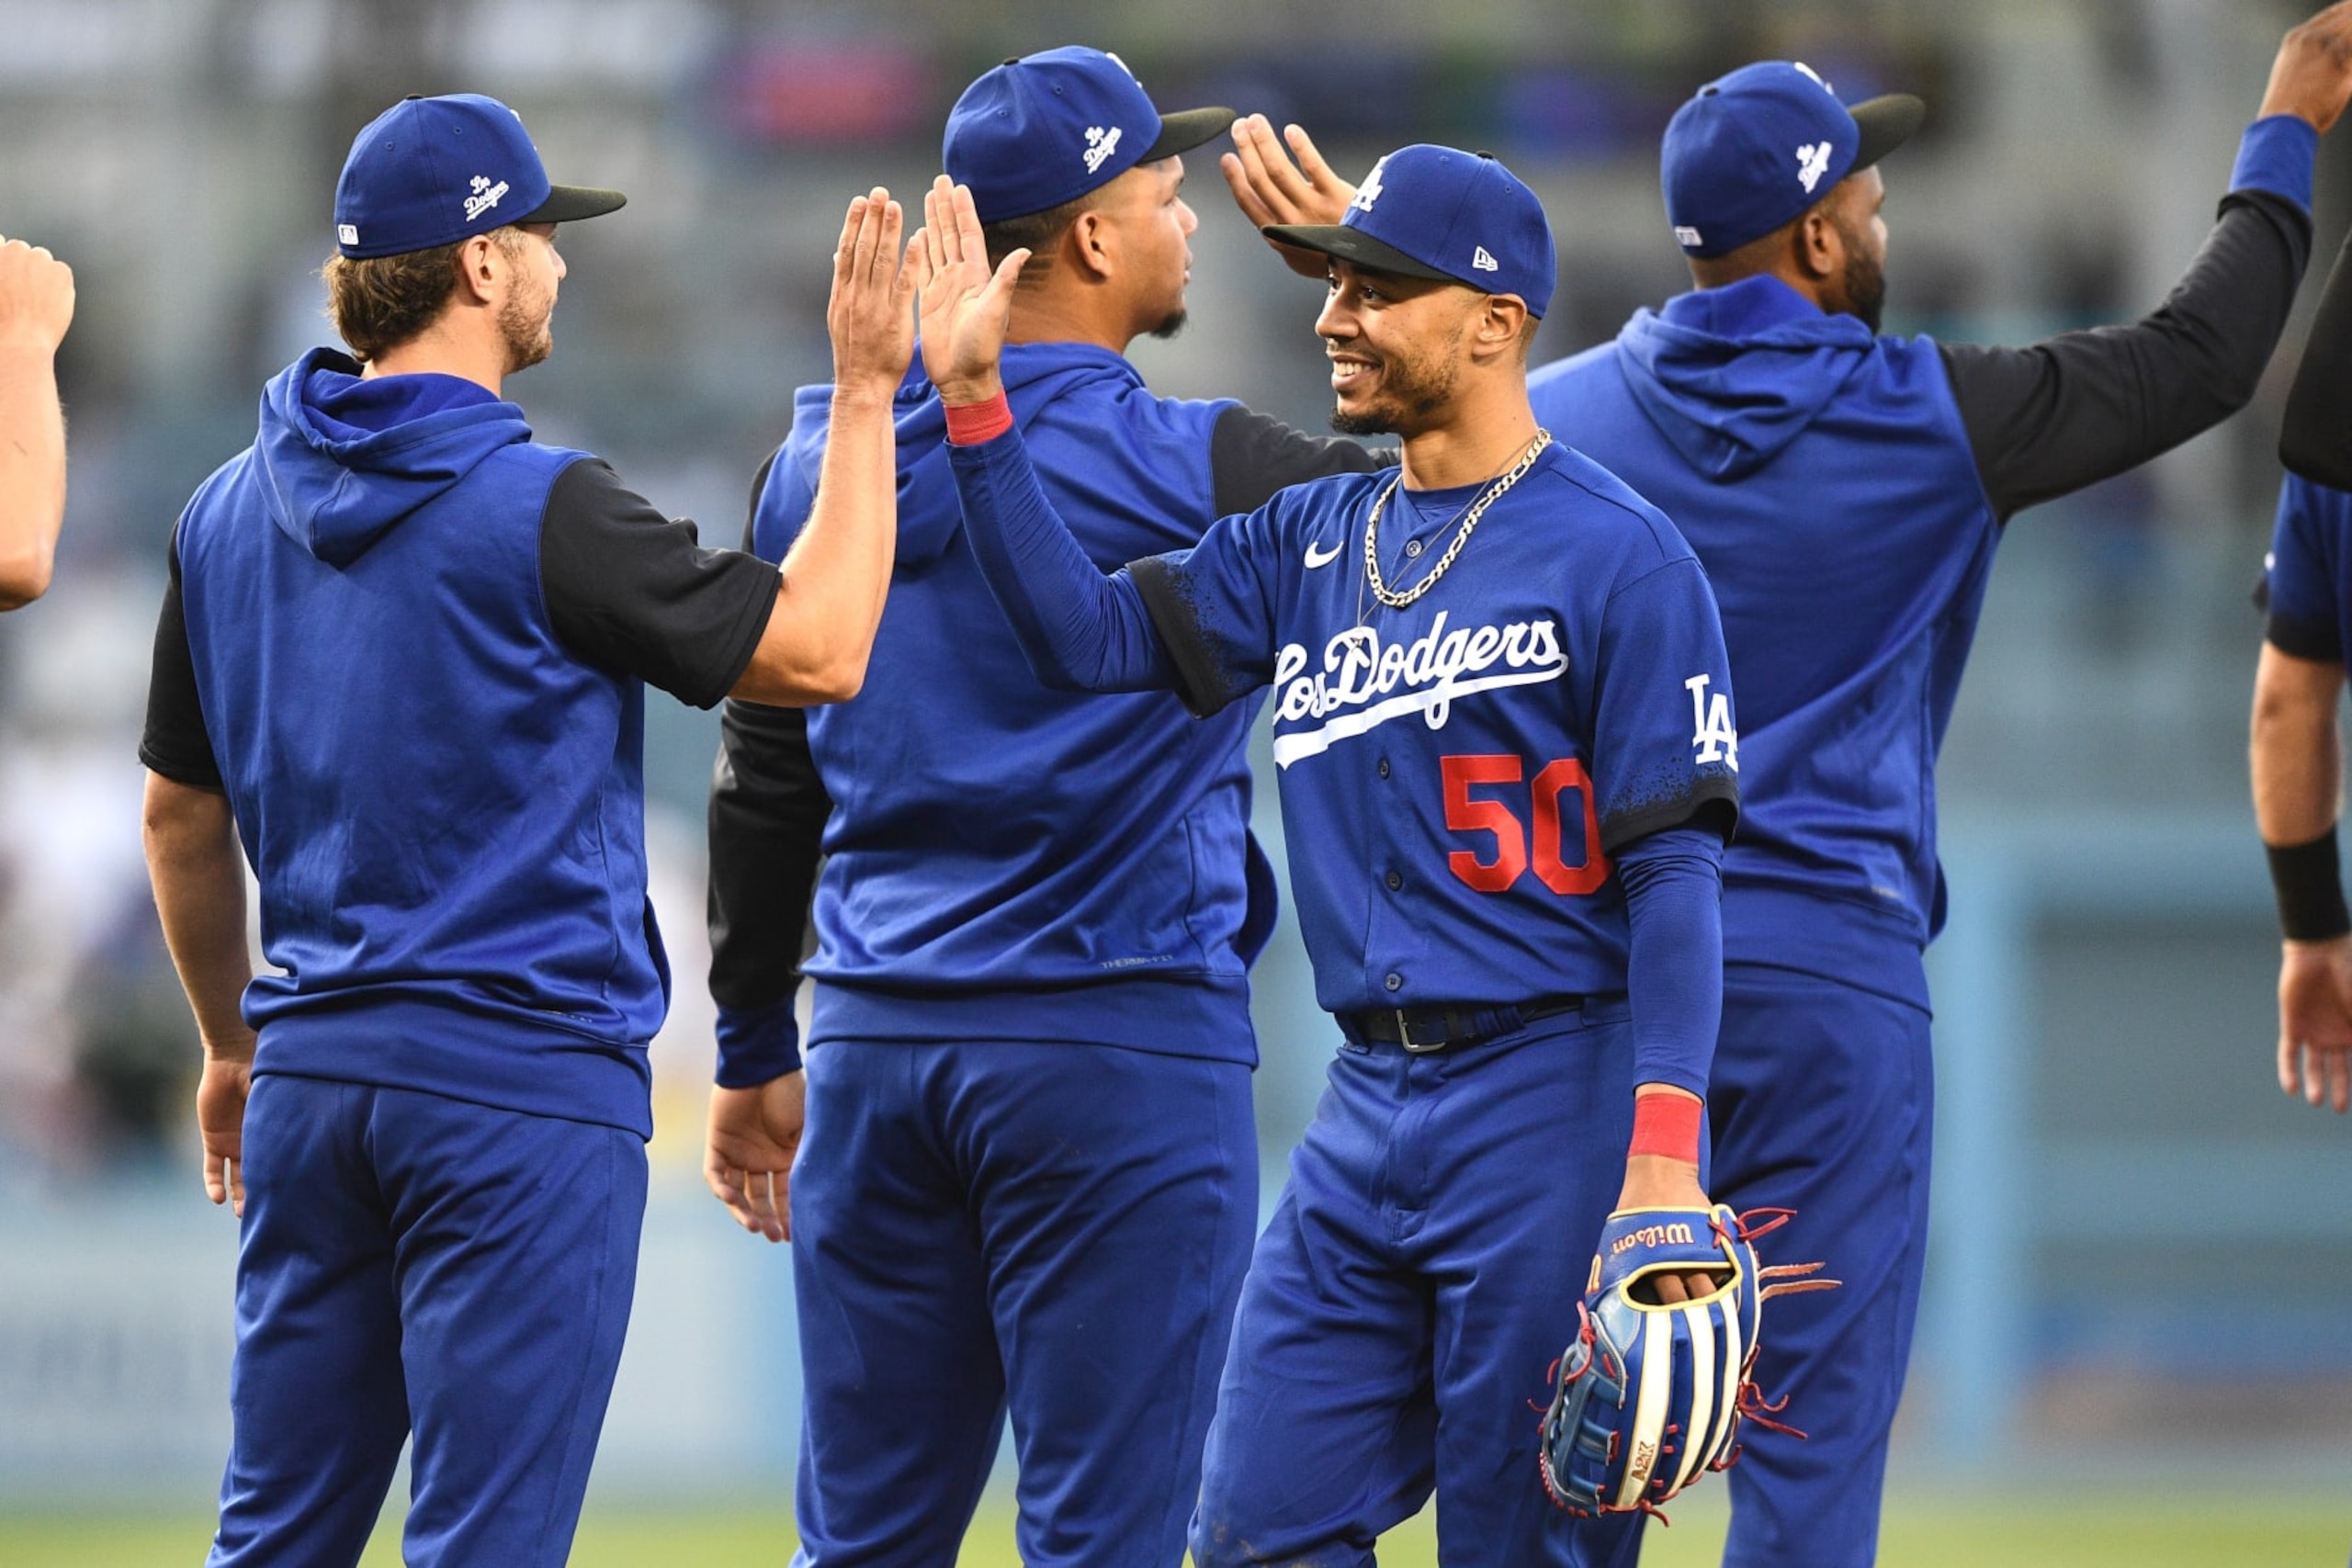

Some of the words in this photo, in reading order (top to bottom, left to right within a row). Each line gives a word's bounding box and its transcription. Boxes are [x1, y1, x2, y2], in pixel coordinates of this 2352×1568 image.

[1272, 643, 1329, 727] Los
[1324, 609, 1568, 730] Dodgers
[1685, 673, 1739, 773] LA
[1440, 754, 1609, 895] 50
[1611, 1223, 1694, 1255] Wilson
[1631, 1439, 1656, 1482] A2K
